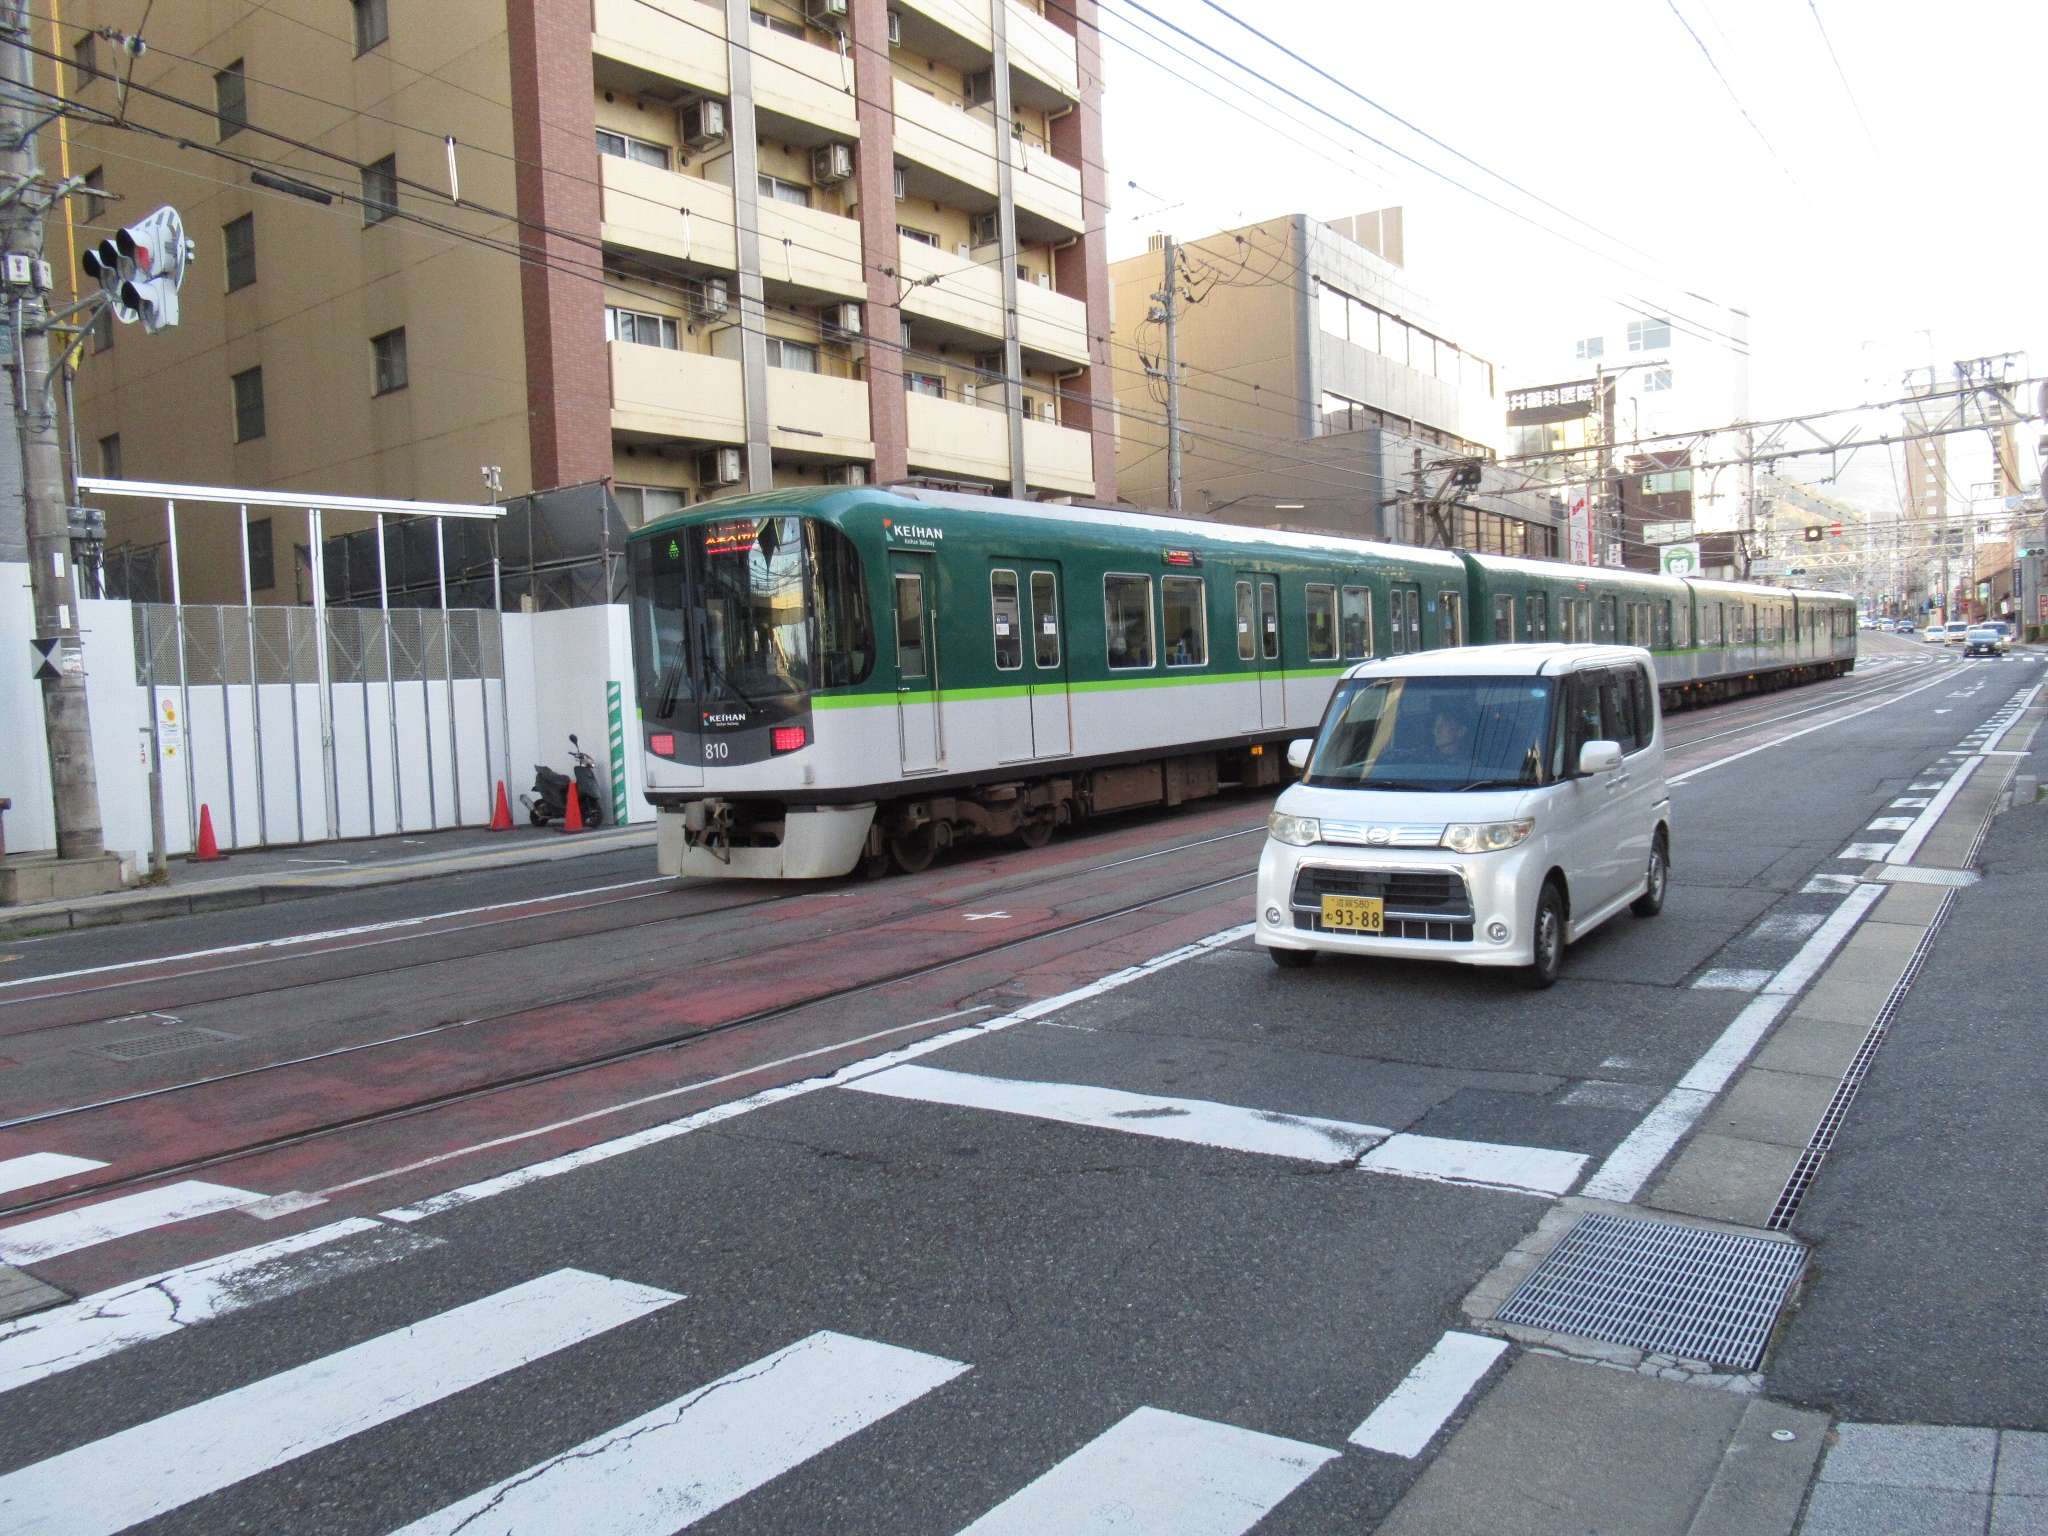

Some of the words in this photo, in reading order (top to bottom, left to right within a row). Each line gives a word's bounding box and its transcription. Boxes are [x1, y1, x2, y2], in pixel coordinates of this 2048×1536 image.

[894, 524, 943, 540] KEIHAN
[709, 713, 746, 722] KEIHAN
[705, 742, 728, 759] 810
[1335, 909, 1380, 928] 93-88
